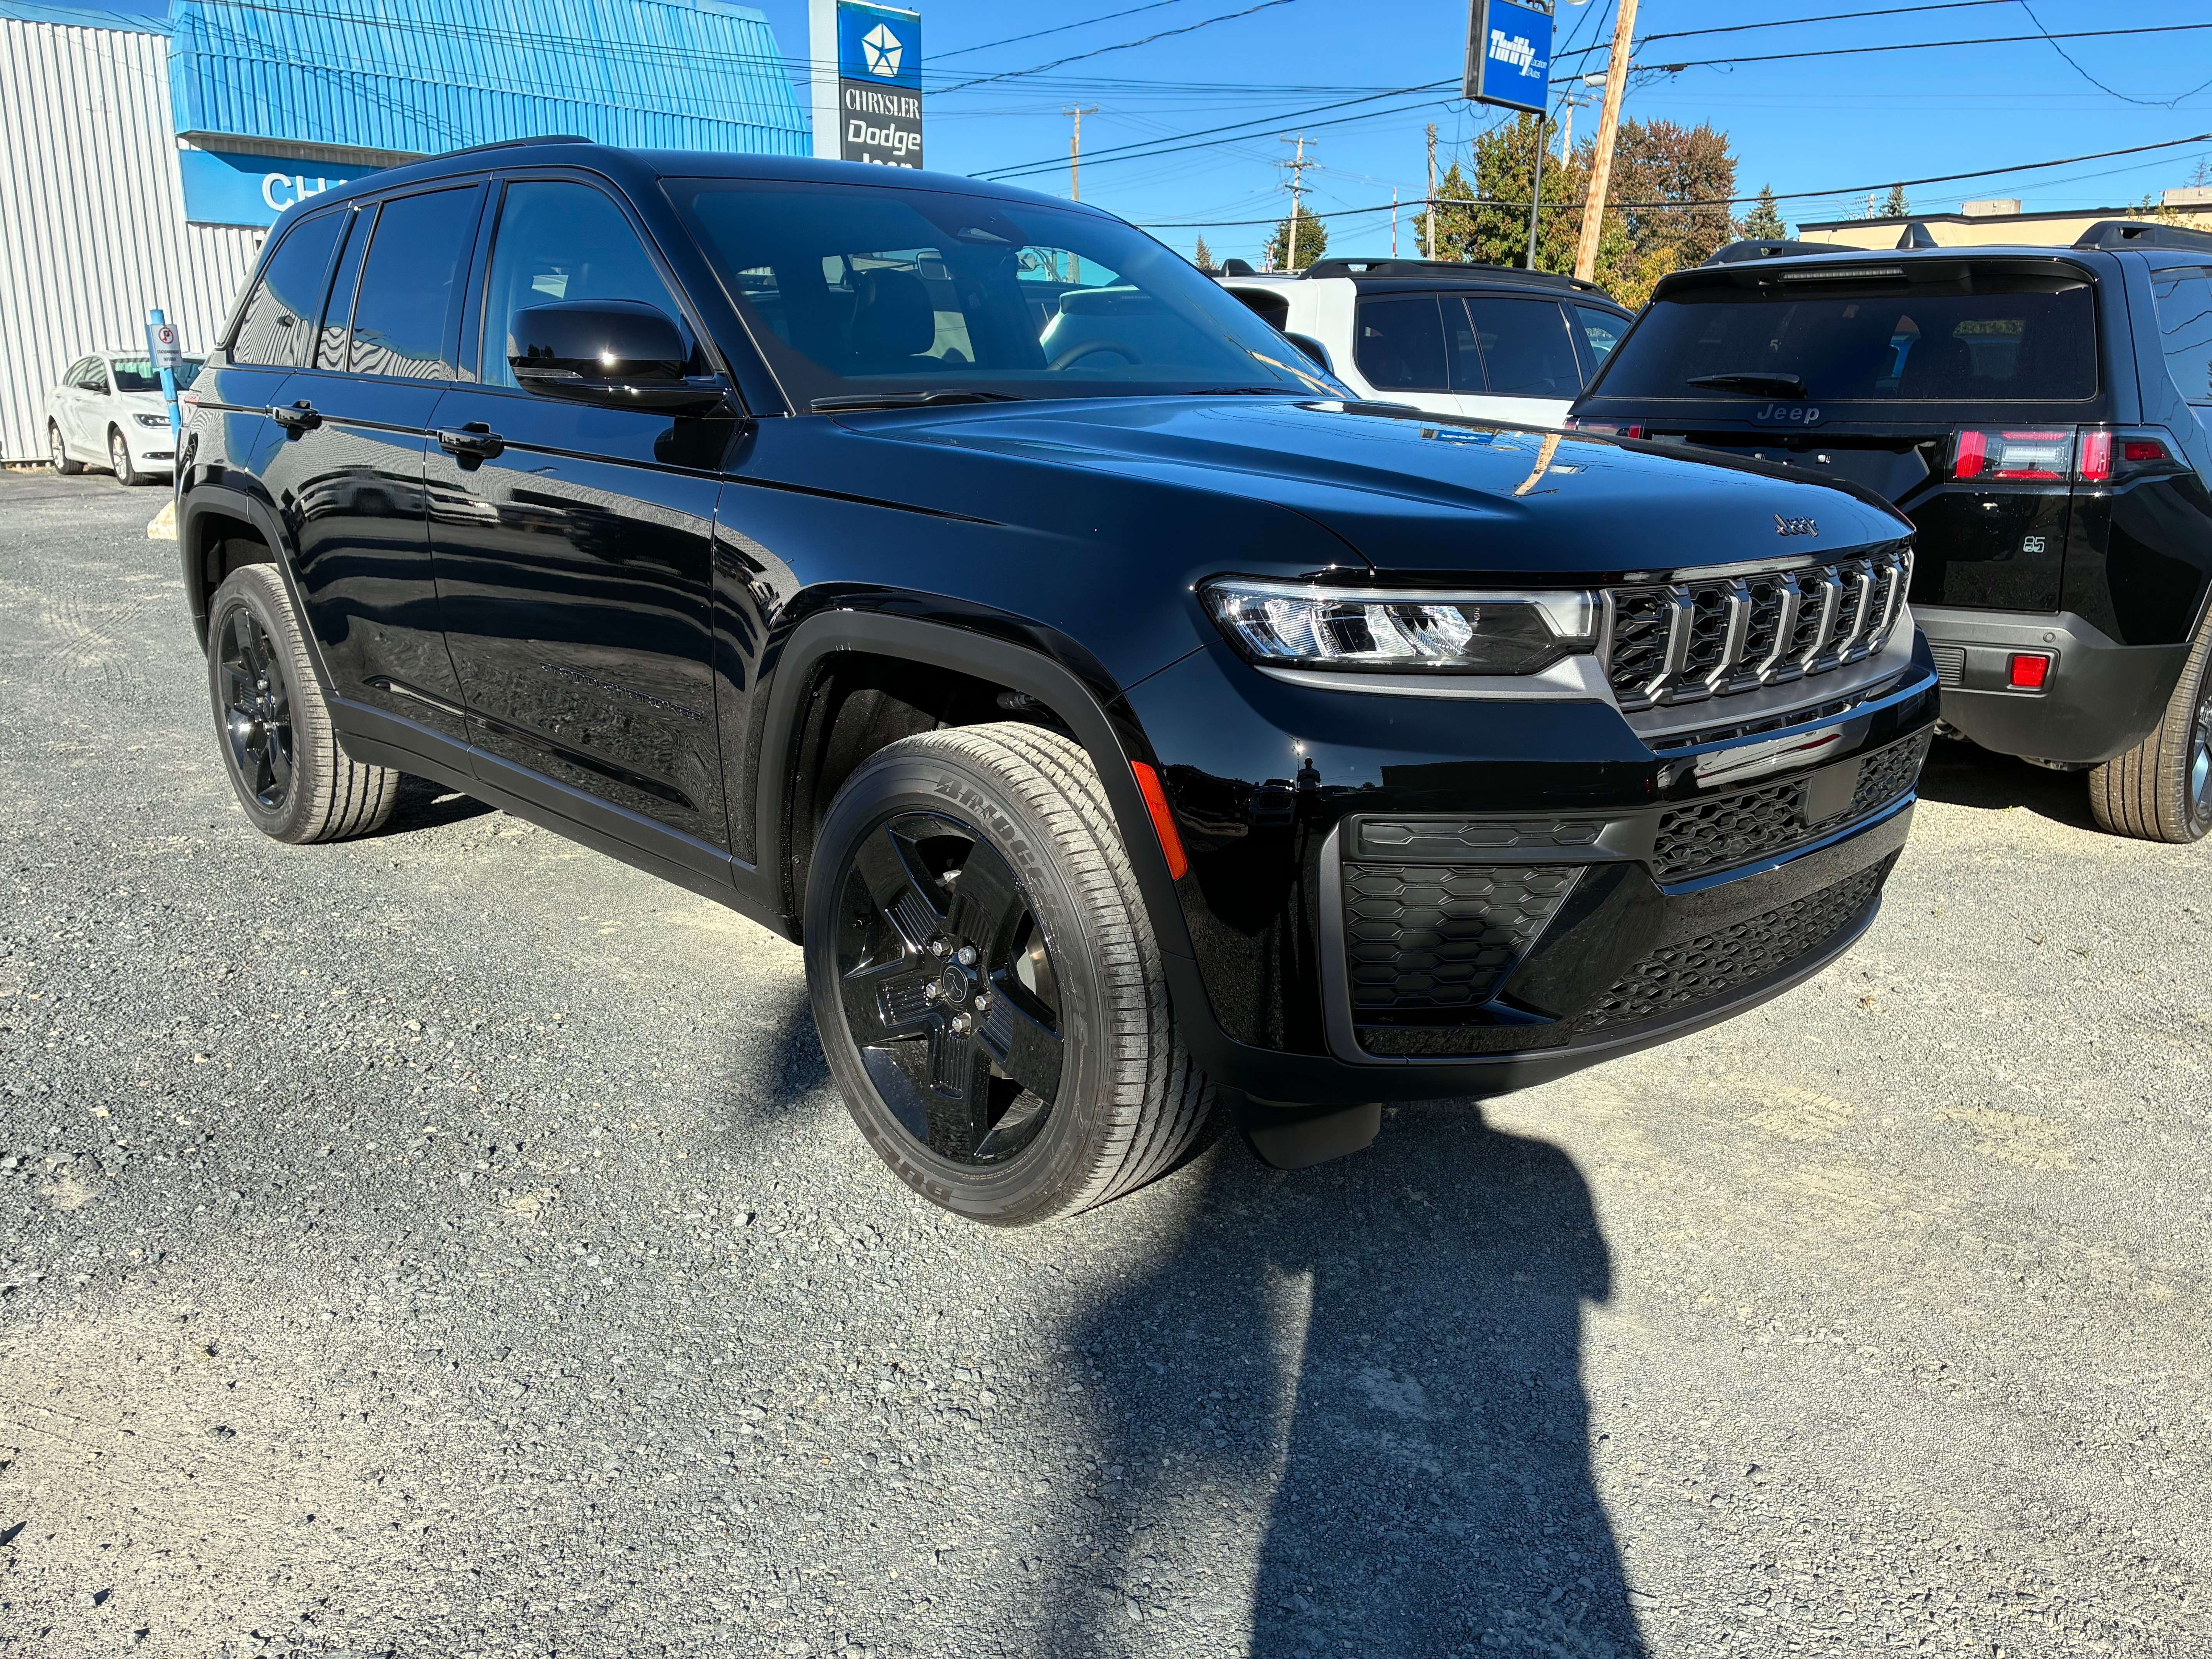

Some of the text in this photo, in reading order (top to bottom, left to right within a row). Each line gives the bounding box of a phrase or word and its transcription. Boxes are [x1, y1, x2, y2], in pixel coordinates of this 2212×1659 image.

[1489, 29, 1536, 76] Thrifty
[846, 89, 921, 119] CHRYSLER
[847, 119, 921, 155] Dodge
[262, 173, 349, 212] CH
[1757, 403, 1820, 424] Jeep
[1773, 513, 1819, 538] Jeep
